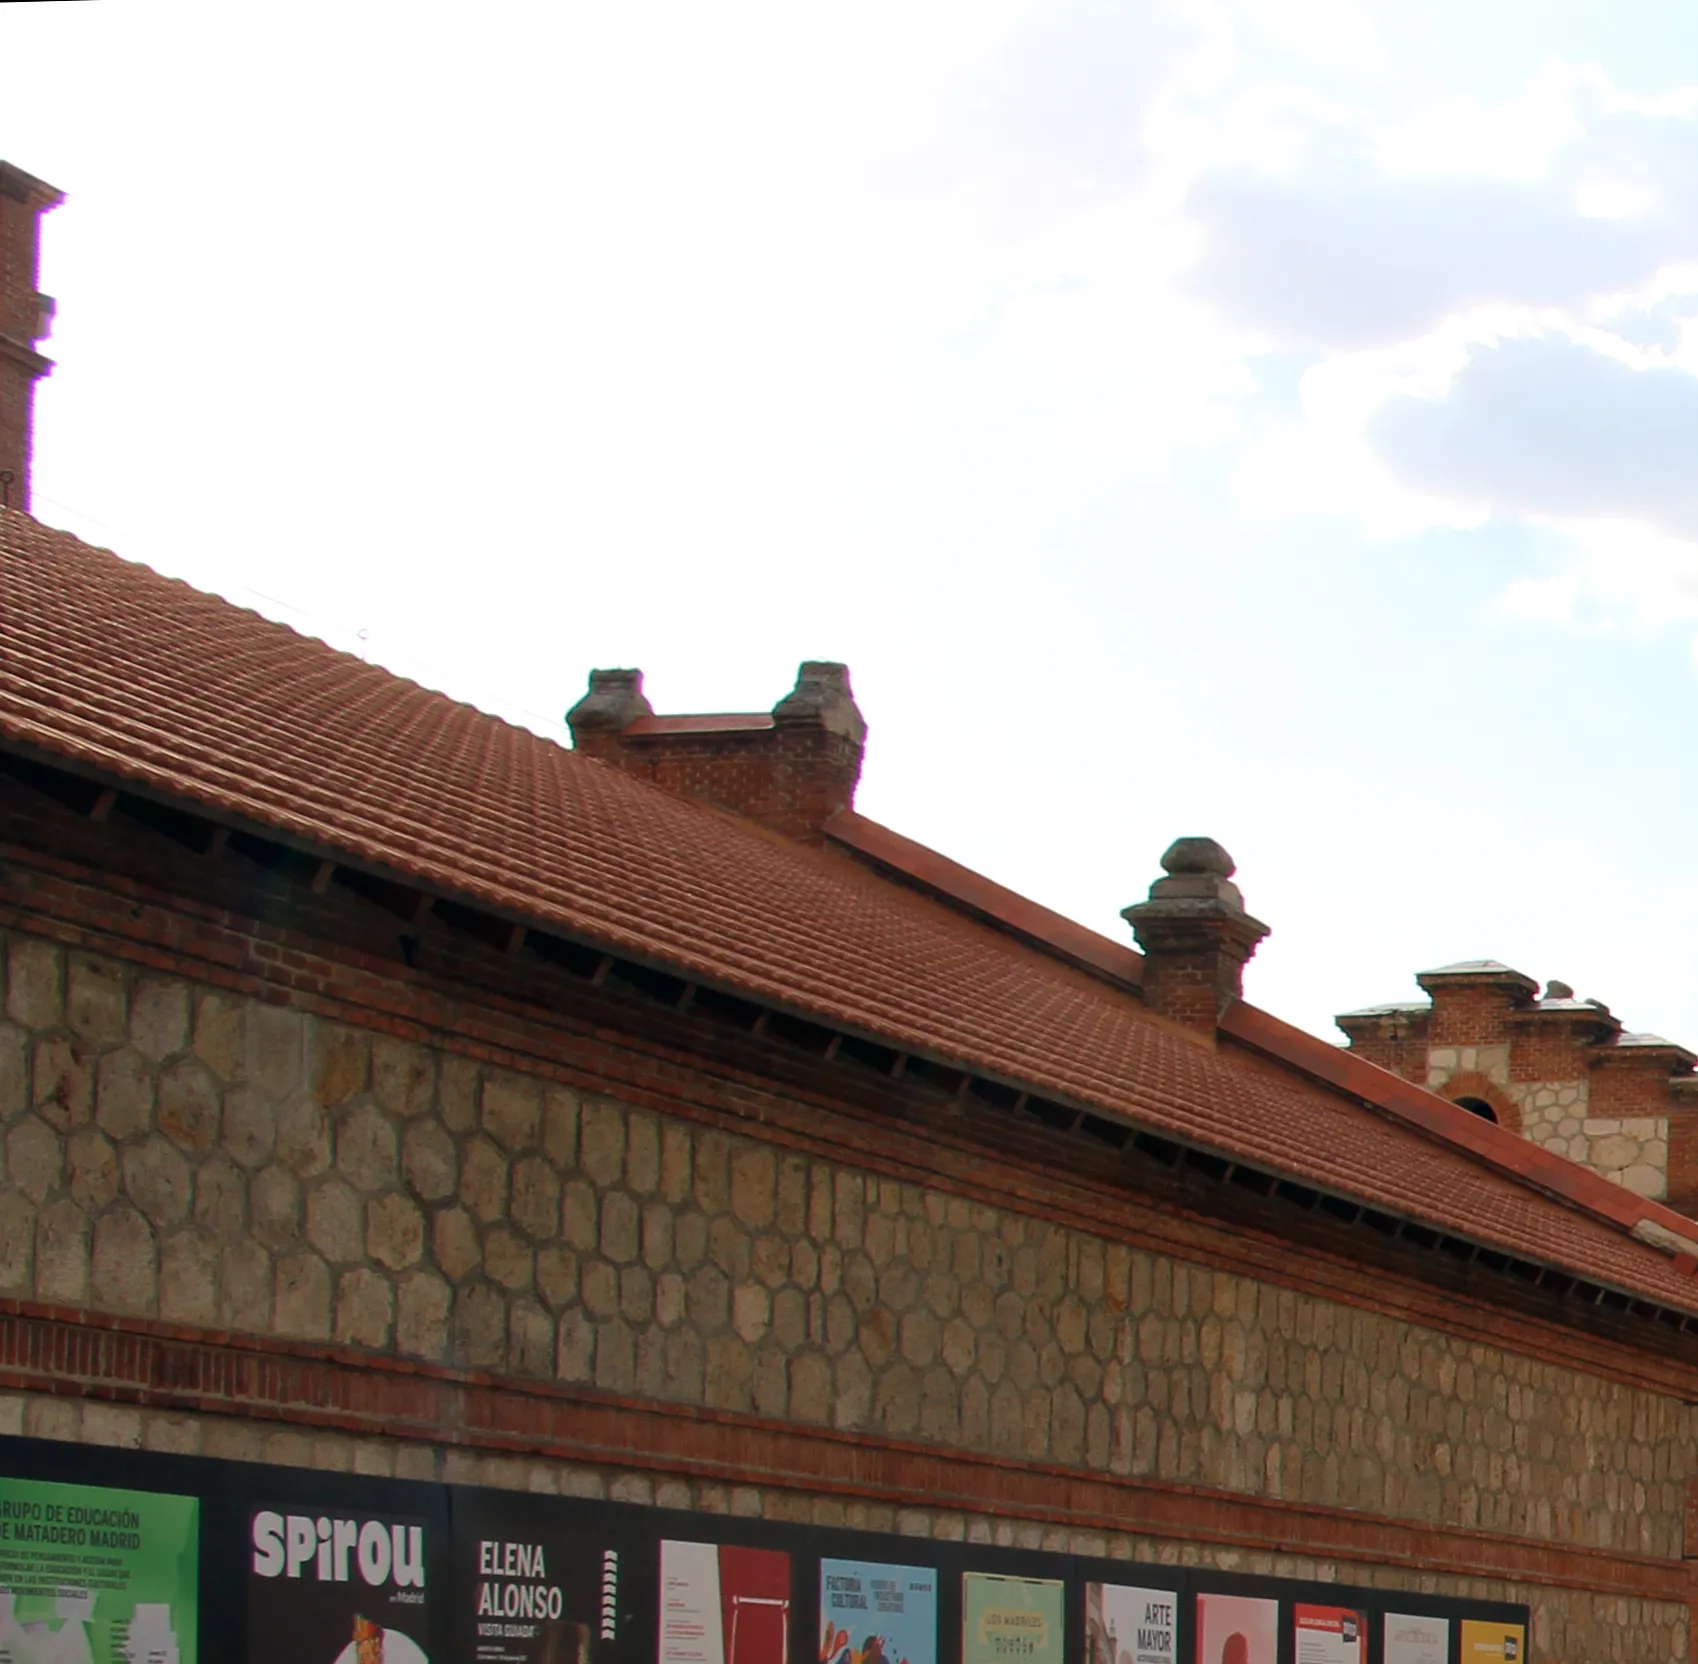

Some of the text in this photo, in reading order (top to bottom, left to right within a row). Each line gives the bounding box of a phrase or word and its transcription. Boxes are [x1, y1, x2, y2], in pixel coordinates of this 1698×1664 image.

[46, 1505, 63, 1522] DE
[67, 1507, 140, 1529] EDUCACIÓN
[14, 1524, 86, 1546] MATADERO
[90, 1533, 140, 1550] MADRID
[479, 1541, 545, 1578] ELENA
[478, 1582, 562, 1619] ALONSO
[1145, 1602, 1172, 1626] ARTE
[478, 1623, 503, 1636] VISITA
[1137, 1629, 1172, 1652] MAYOR
